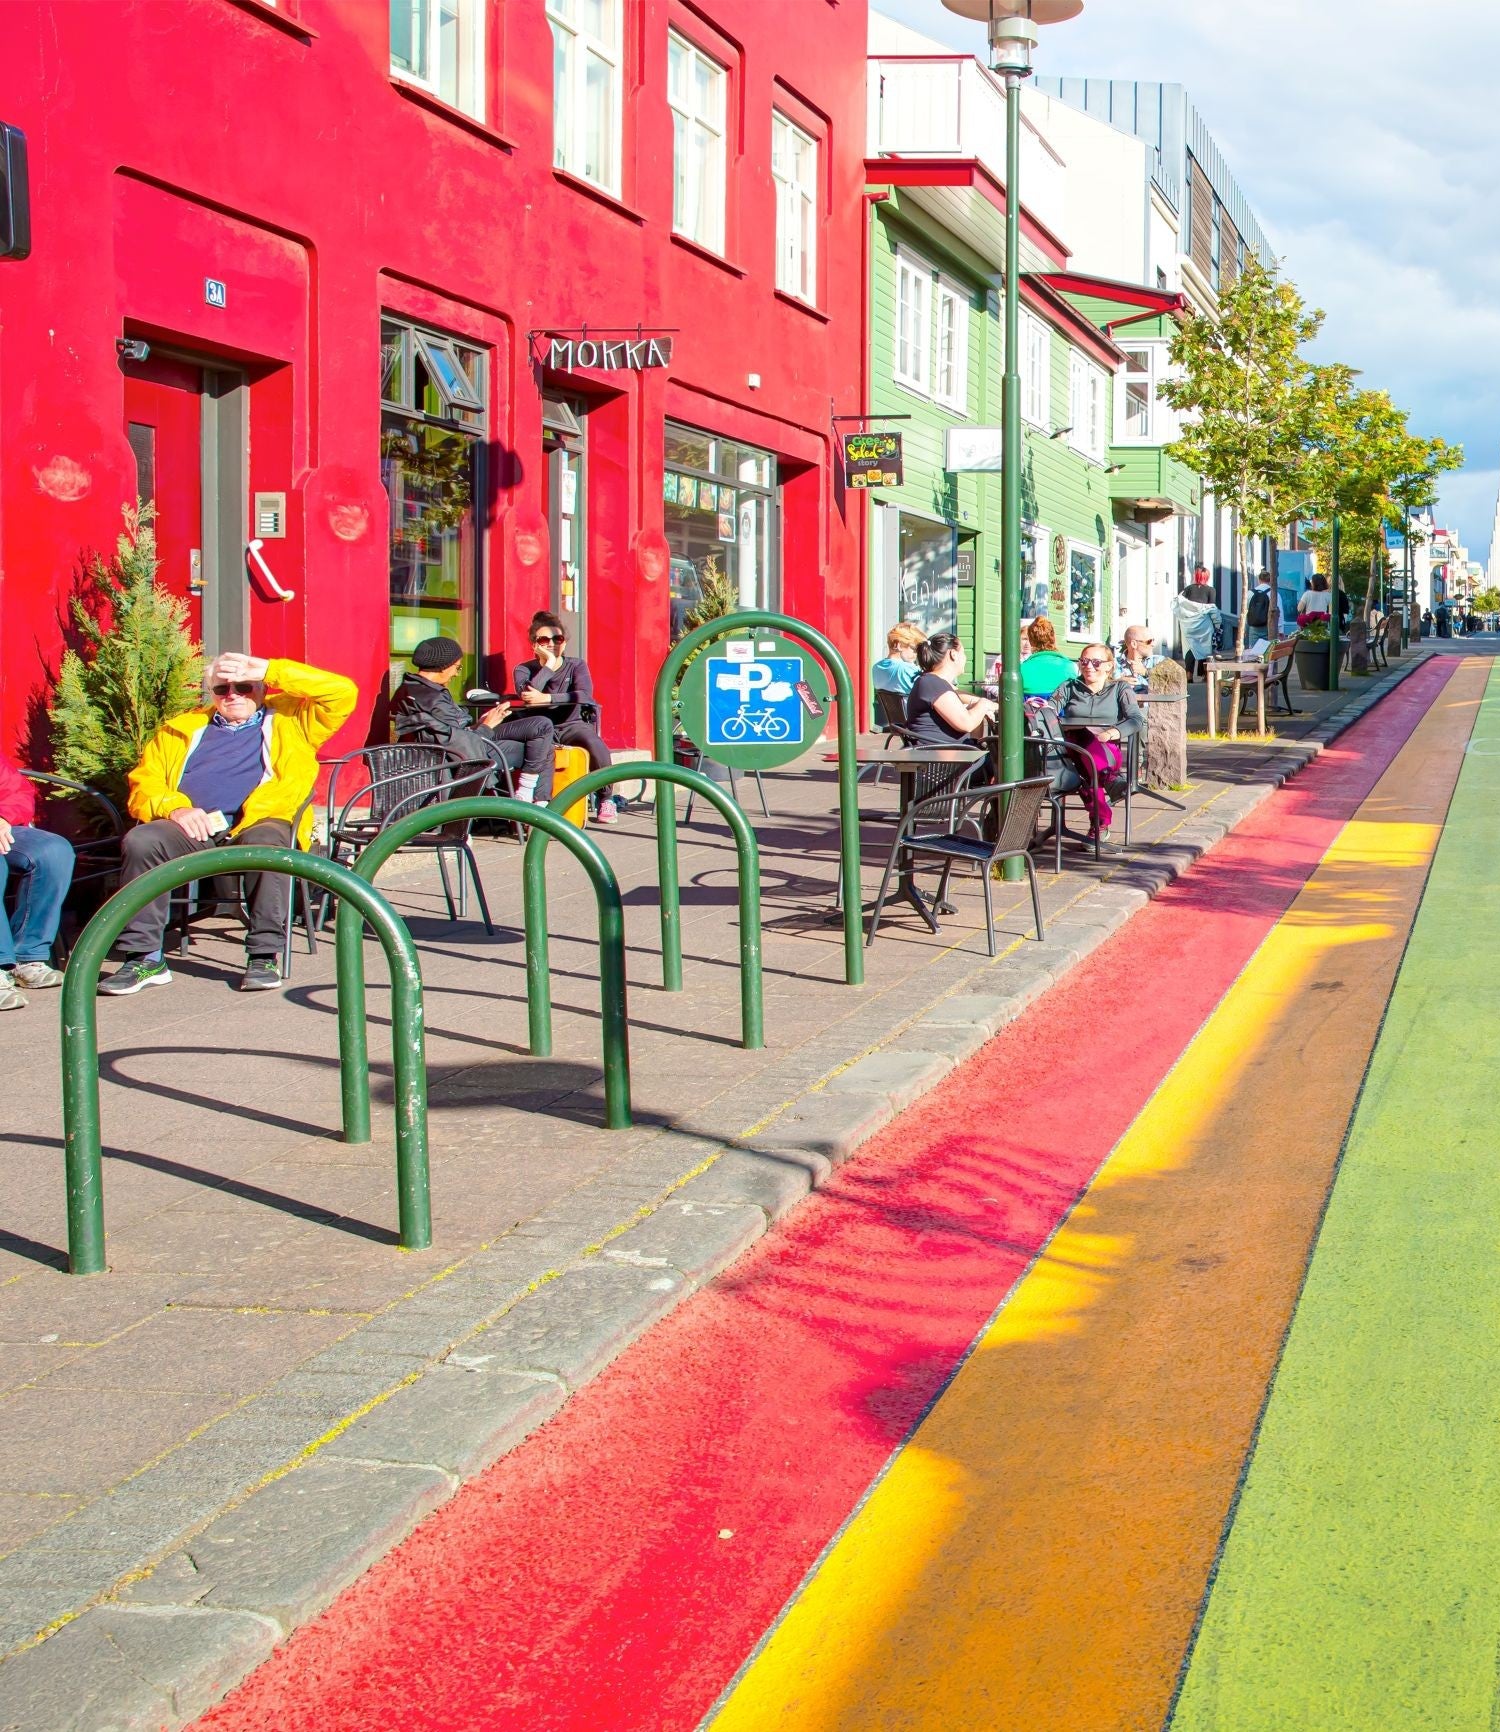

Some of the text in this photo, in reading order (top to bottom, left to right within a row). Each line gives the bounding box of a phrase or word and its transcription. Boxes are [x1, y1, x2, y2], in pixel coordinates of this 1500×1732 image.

[209, 282, 223, 304] 3A
[550, 338, 669, 375] MOKKA
[852, 436, 885, 447] Green
[739, 663, 773, 702] P
